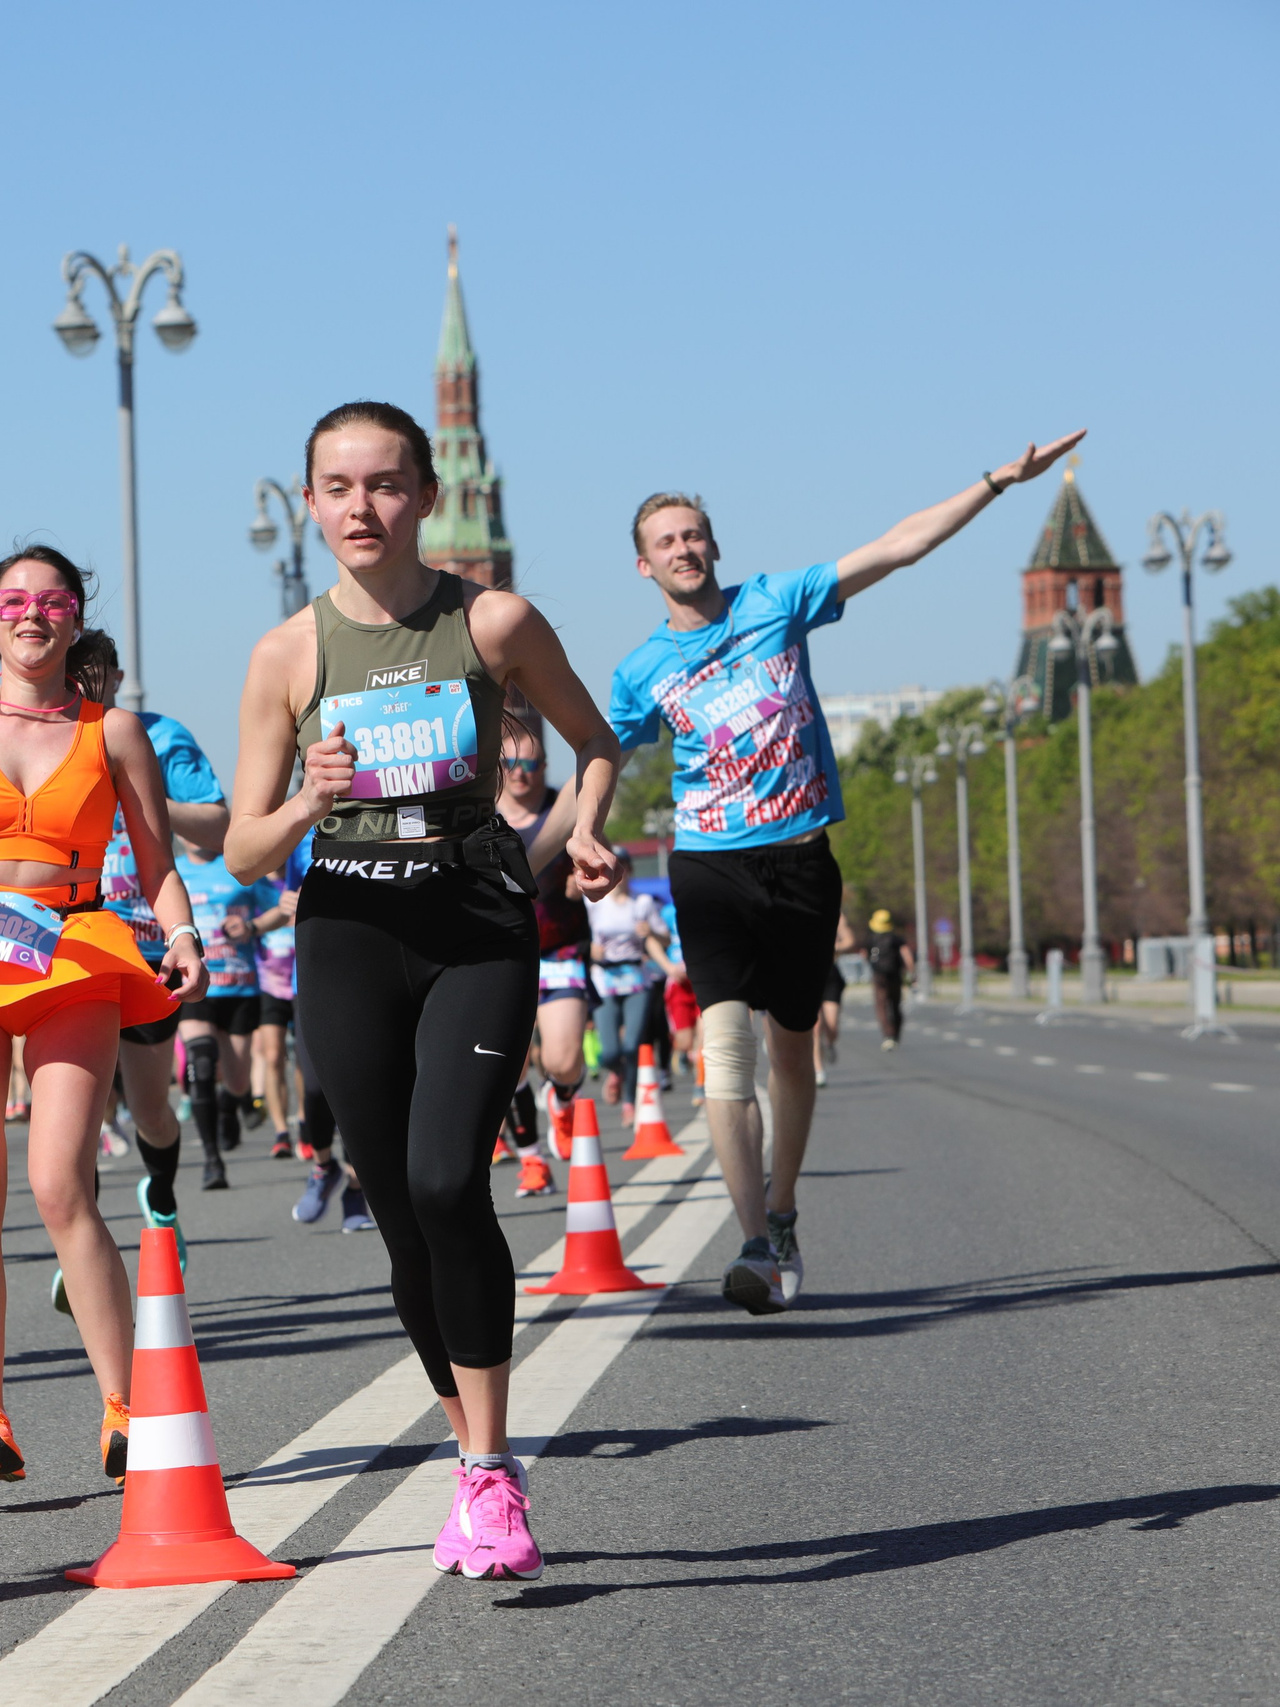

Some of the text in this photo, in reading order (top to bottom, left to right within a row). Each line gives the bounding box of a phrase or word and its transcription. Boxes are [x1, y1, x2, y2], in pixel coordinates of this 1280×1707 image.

[371, 666, 422, 687] NIKE
[340, 697, 363, 708] ПСБ
[704, 678, 761, 724] 33262
[726, 704, 764, 737] 10KM
[354, 717, 447, 765] 33881
[376, 762, 436, 798] 10KM
[454, 764, 465, 778] D
[20, 951, 30, 962] C
